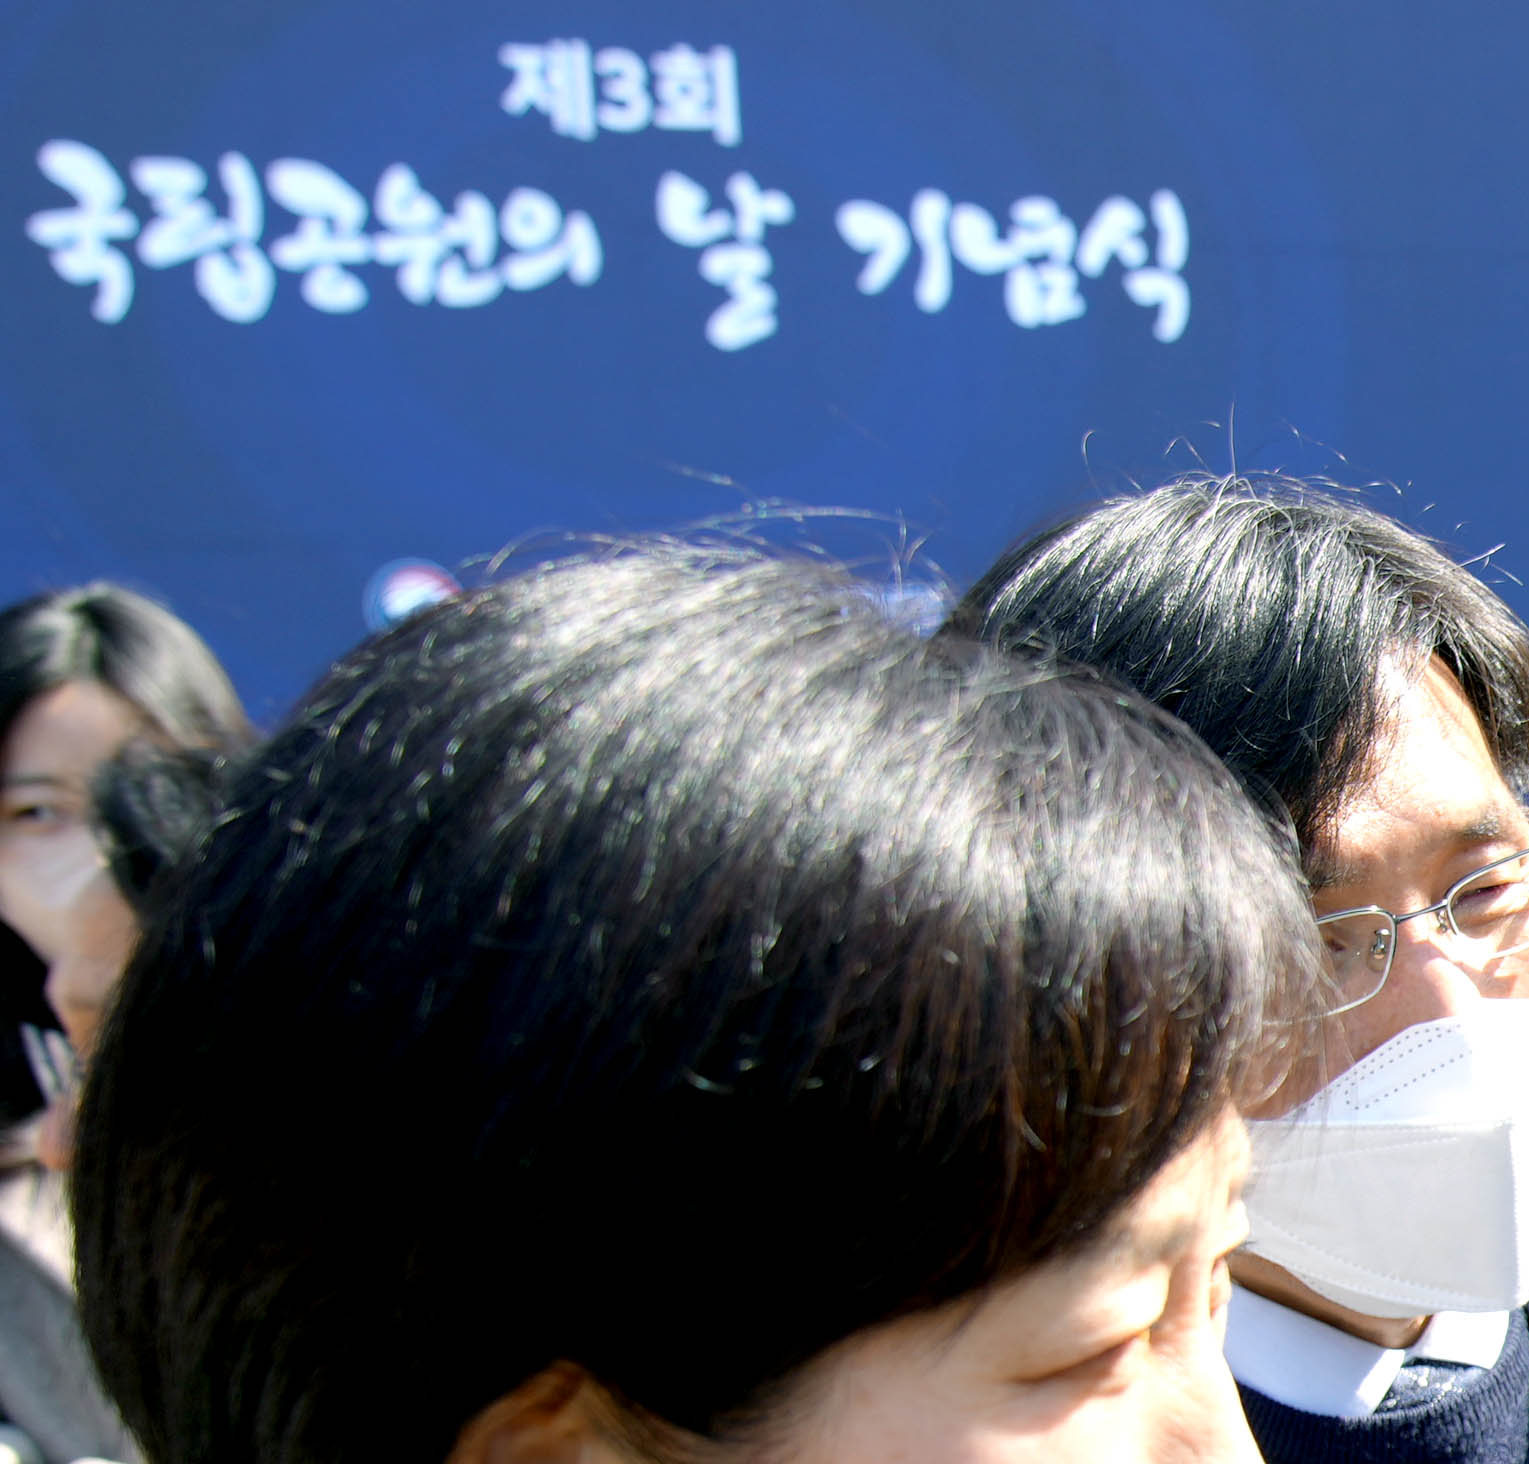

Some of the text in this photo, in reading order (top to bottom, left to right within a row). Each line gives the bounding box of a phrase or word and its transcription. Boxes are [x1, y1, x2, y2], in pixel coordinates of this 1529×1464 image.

[500, 39, 740, 145] 제3회
[28, 141, 1189, 350] 국립공원의 날 기념식
